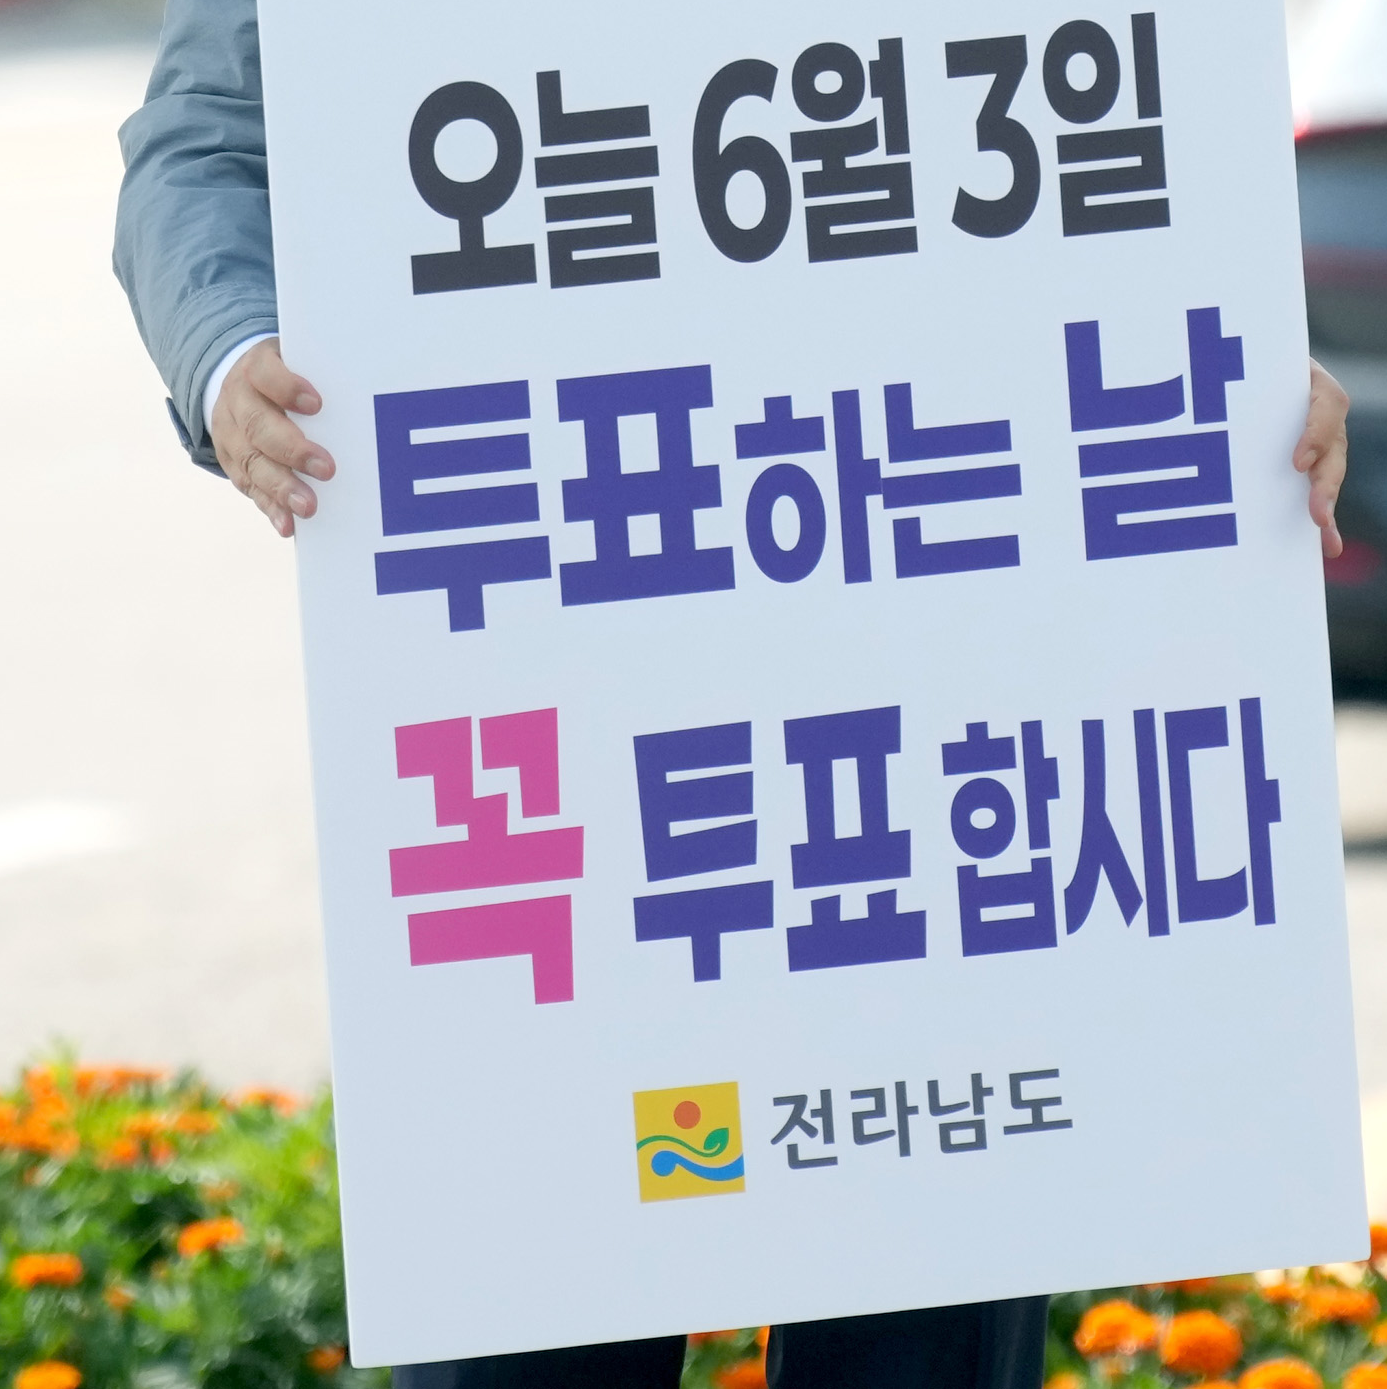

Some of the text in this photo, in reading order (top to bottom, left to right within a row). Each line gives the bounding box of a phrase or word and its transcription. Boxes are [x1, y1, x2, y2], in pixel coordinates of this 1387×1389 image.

[408, 11, 1171, 296] 오늘 6월 3일
[373, 364, 1023, 633] 투표하는
[1064, 306, 1245, 562] 날
[389, 707, 584, 1005] 꼭
[770, 1068, 1073, 1170] 전라남도
